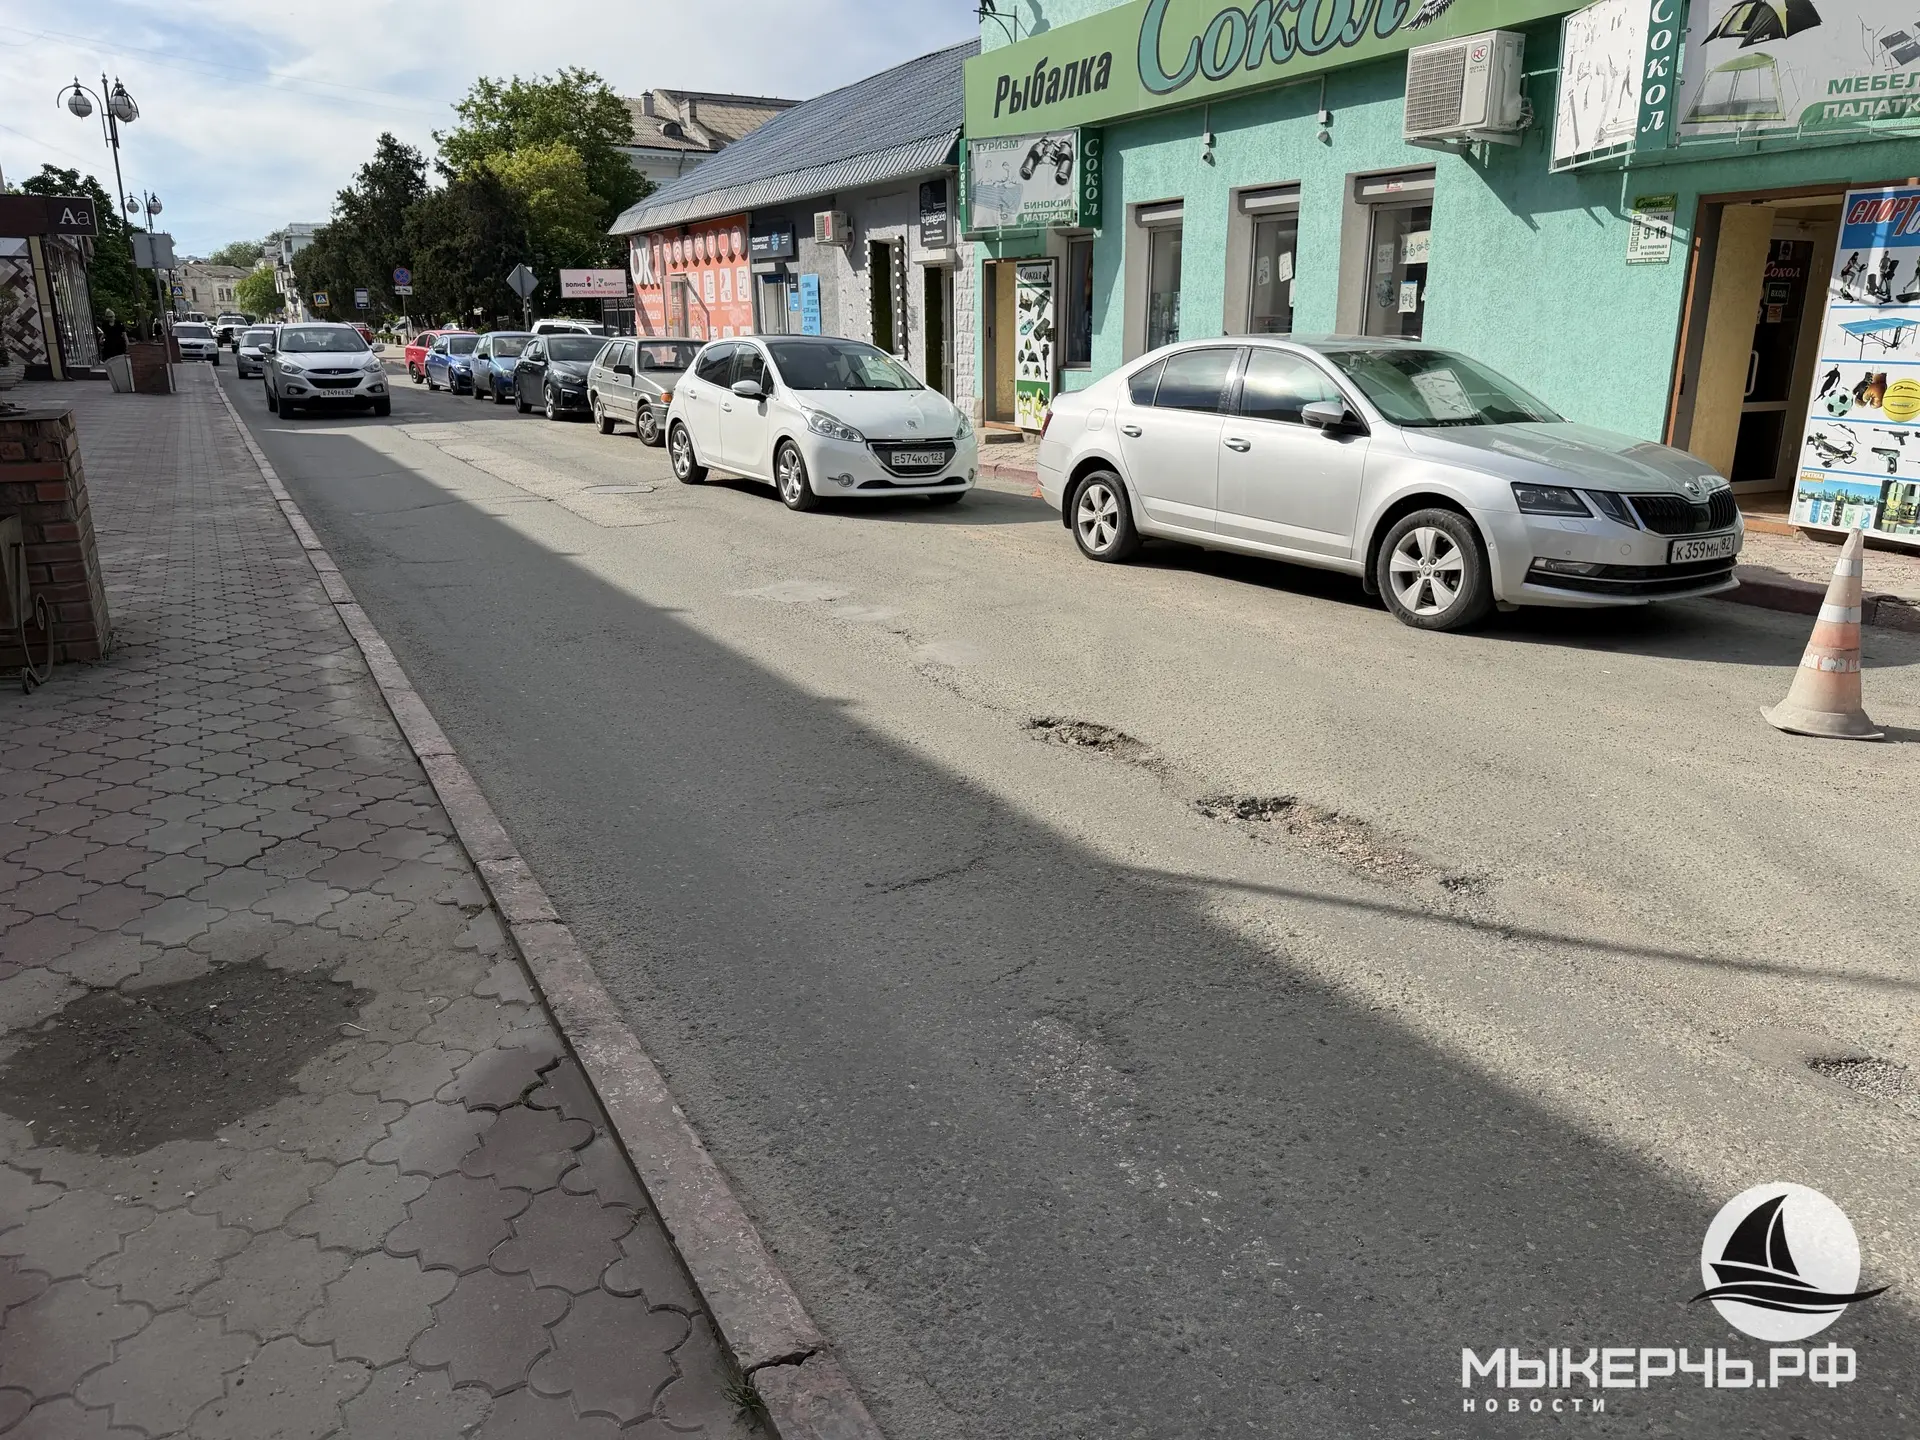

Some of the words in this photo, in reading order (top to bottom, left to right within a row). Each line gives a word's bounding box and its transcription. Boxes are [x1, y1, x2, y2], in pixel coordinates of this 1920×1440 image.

[1137, 0, 1407, 95] Сокол
[1641, 0, 1673, 133] Сокол
[994, 51, 1113, 118] Рыбалка
[976, 140, 1019, 152] ТУРИЗМ
[1084, 138, 1099, 215] Сокол
[1023, 199, 1071, 215] БИНОКЛИ
[1023, 211, 1071, 227] МАТРАЦЫ
[1643, 225, 1667, 240] 9-18
[1764, 261, 1801, 278] Сокол
[1770, 289, 1787, 298] ВХОД
[930, 452, 943, 461] 123
[1721, 536, 1731, 551] 82
